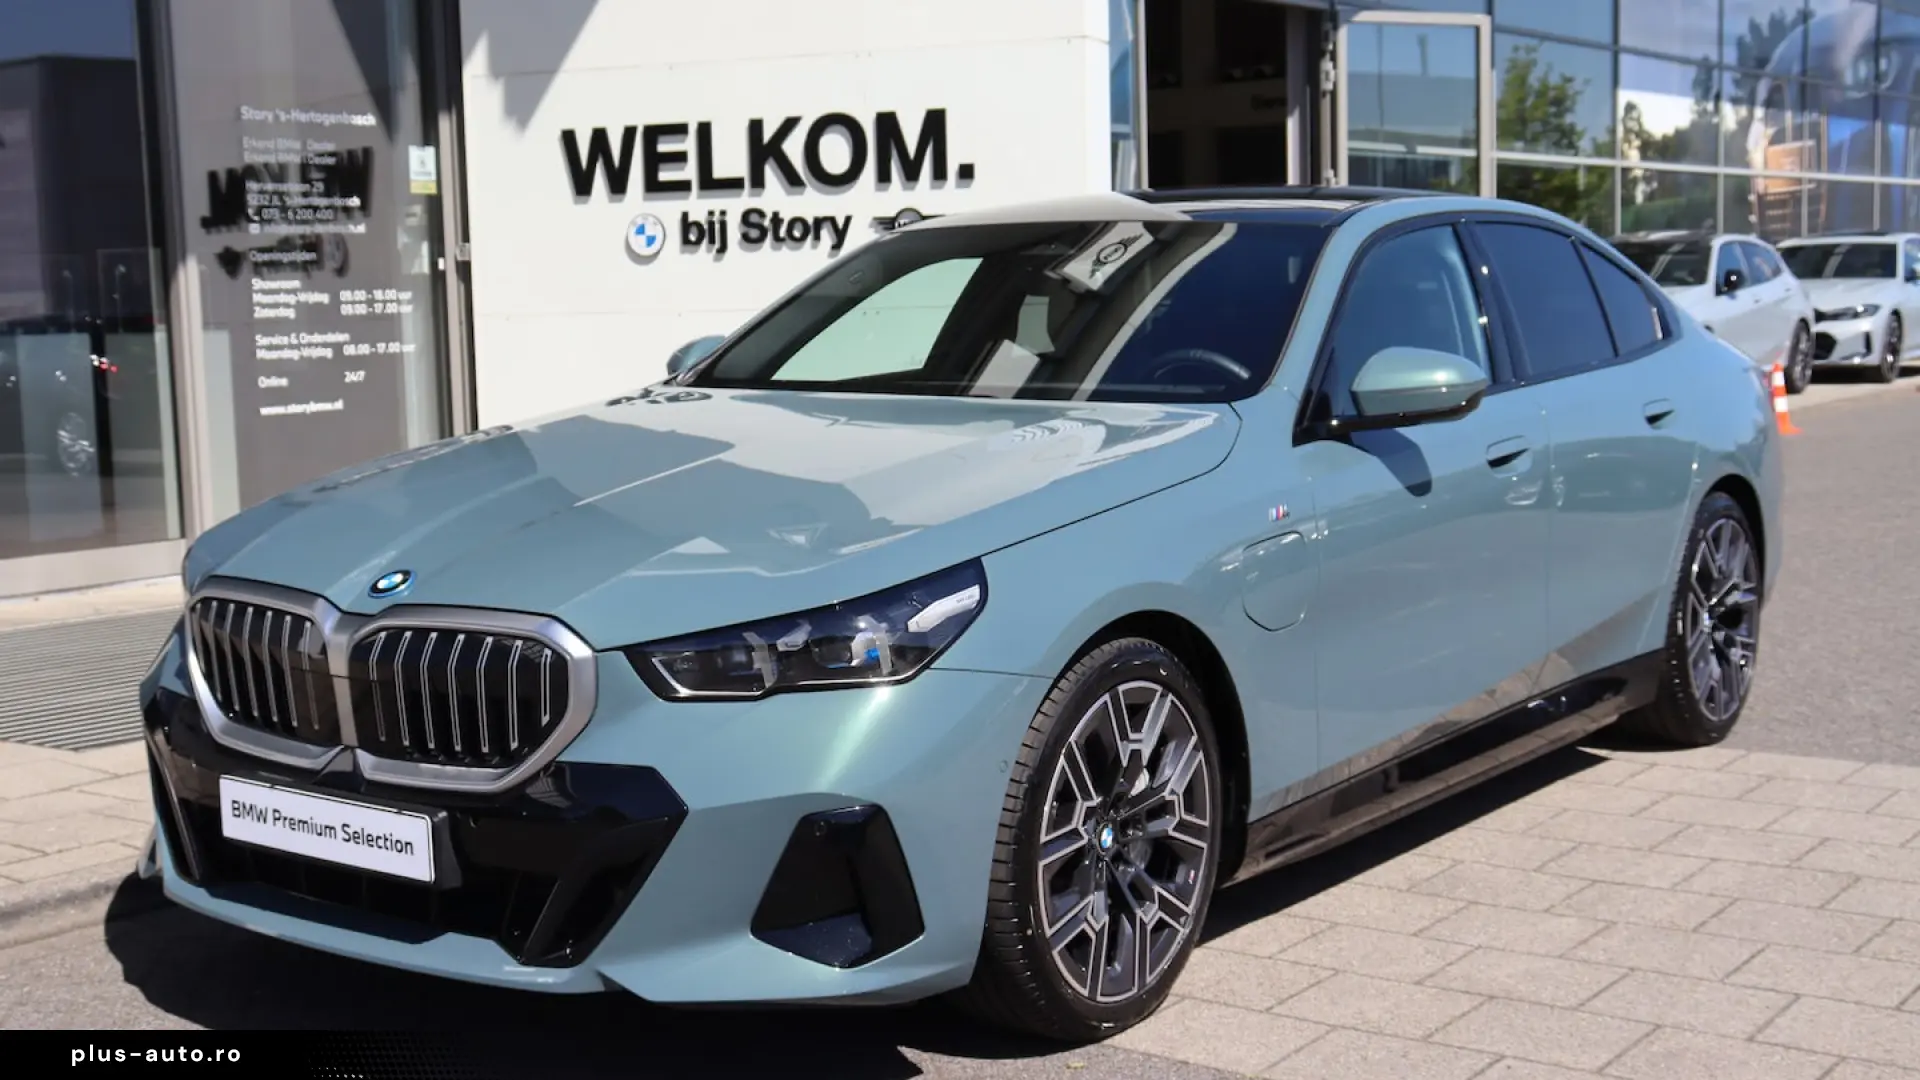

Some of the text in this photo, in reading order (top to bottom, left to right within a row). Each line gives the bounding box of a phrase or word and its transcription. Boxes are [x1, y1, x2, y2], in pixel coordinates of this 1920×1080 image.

[240, 105, 273, 123] Story
[560, 107, 976, 198] WELKOM.
[295, 208, 313, 220] 200
[314, 208, 334, 220] 400
[680, 208, 853, 254] bij Story
[252, 278, 301, 290] Showroom
[255, 334, 289, 346] Service
[290, 333, 298, 345] &
[258, 370, 366, 388] Online 24/7
[231, 799, 415, 856] BMW Premium Selection
